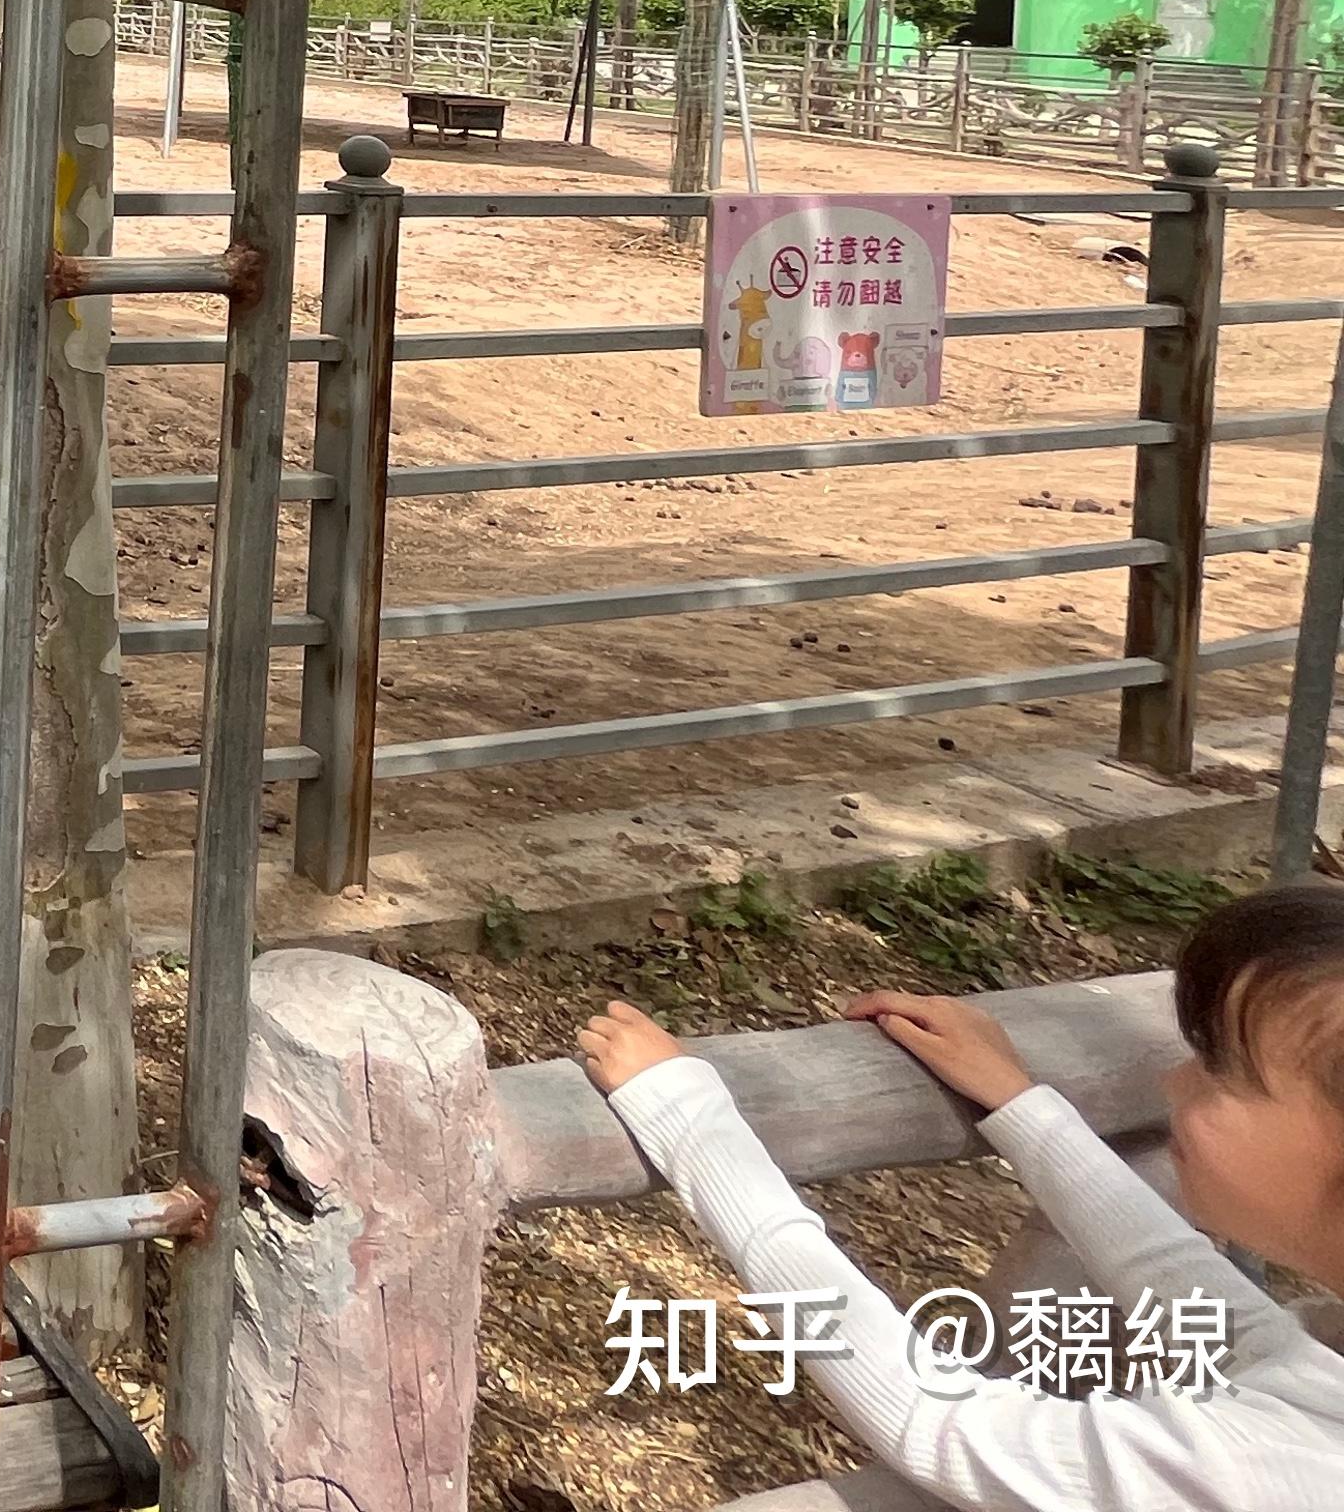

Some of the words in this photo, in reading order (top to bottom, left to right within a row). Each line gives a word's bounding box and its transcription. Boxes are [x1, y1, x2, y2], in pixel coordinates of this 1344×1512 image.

[813, 236, 905, 265] 注意安全
[812, 279, 903, 308] 请勿翻越
